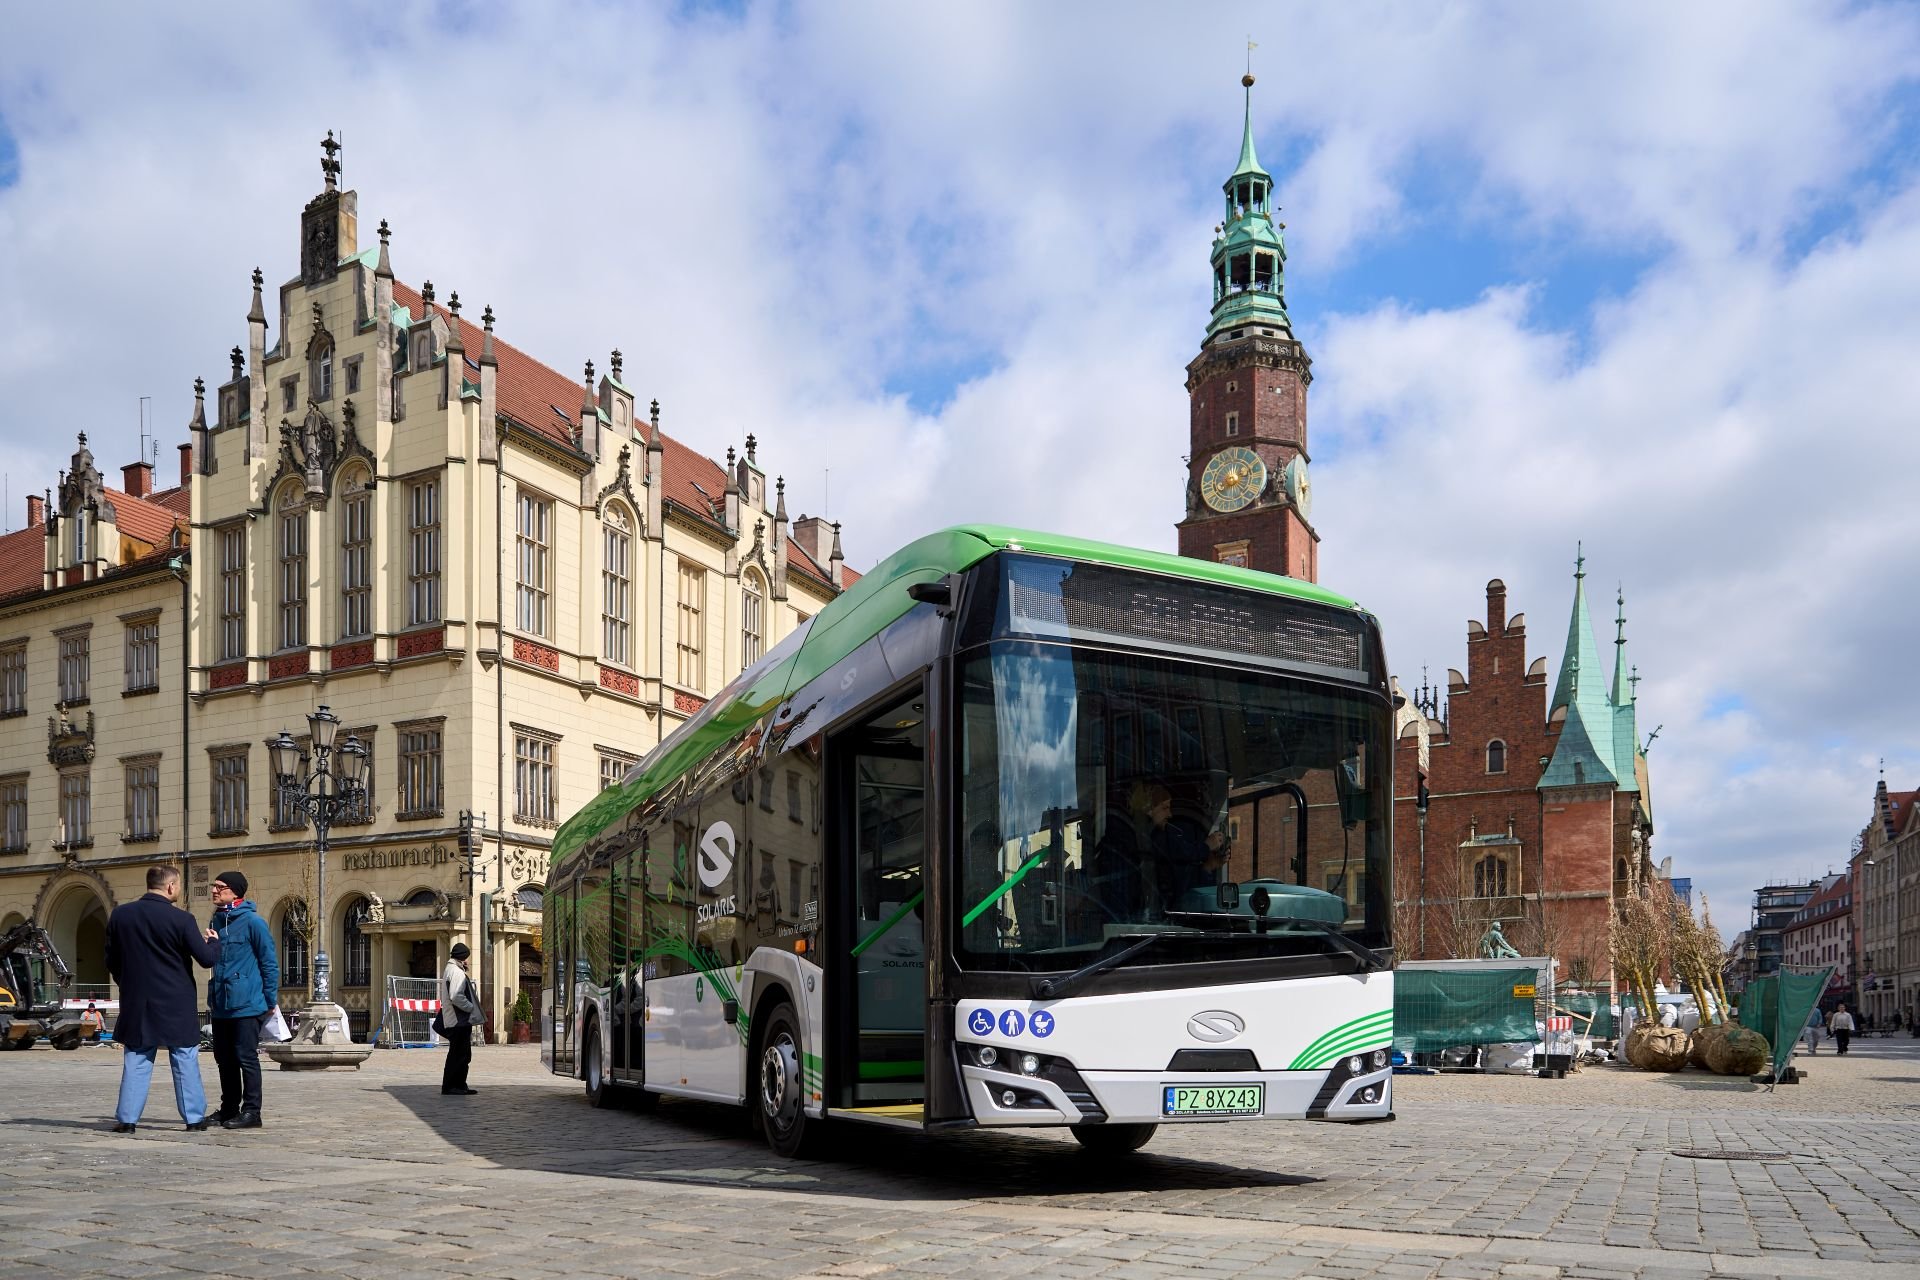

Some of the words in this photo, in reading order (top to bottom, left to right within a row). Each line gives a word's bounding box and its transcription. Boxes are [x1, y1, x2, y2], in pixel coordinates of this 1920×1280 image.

[341, 842, 448, 871] restauracja
[511, 845, 551, 881] Spi
[697, 894, 736, 924] SOLARIS
[778, 926, 794, 938] Urbino
[799, 920, 818, 933] electric
[882, 960, 924, 968] SOLARIS
[1178, 1090, 1199, 1109] PZ
[1206, 1089, 1256, 1108] 8X243
